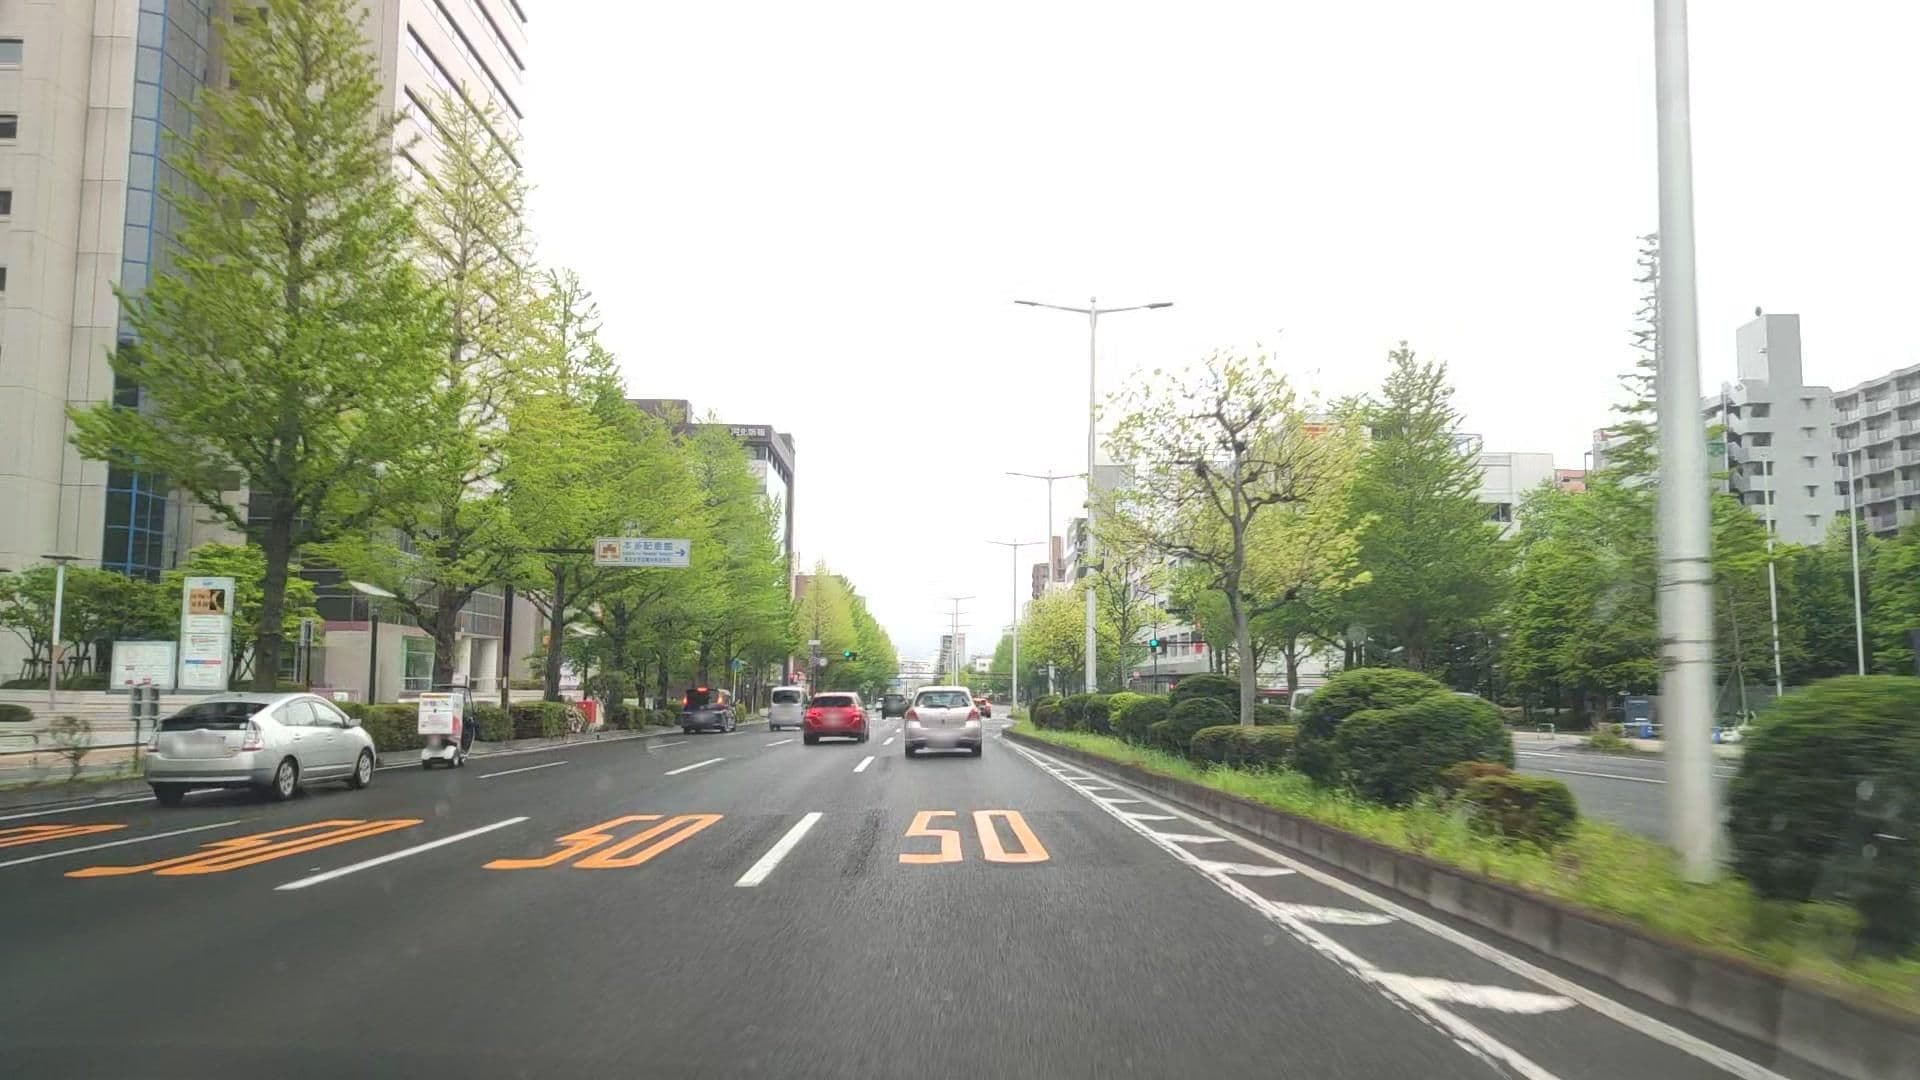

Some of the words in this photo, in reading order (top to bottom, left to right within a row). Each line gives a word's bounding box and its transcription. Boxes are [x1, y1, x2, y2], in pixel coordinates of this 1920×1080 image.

[65, 818, 422, 878] 50
[485, 814, 723, 869] 50
[899, 811, 1050, 863] 50
